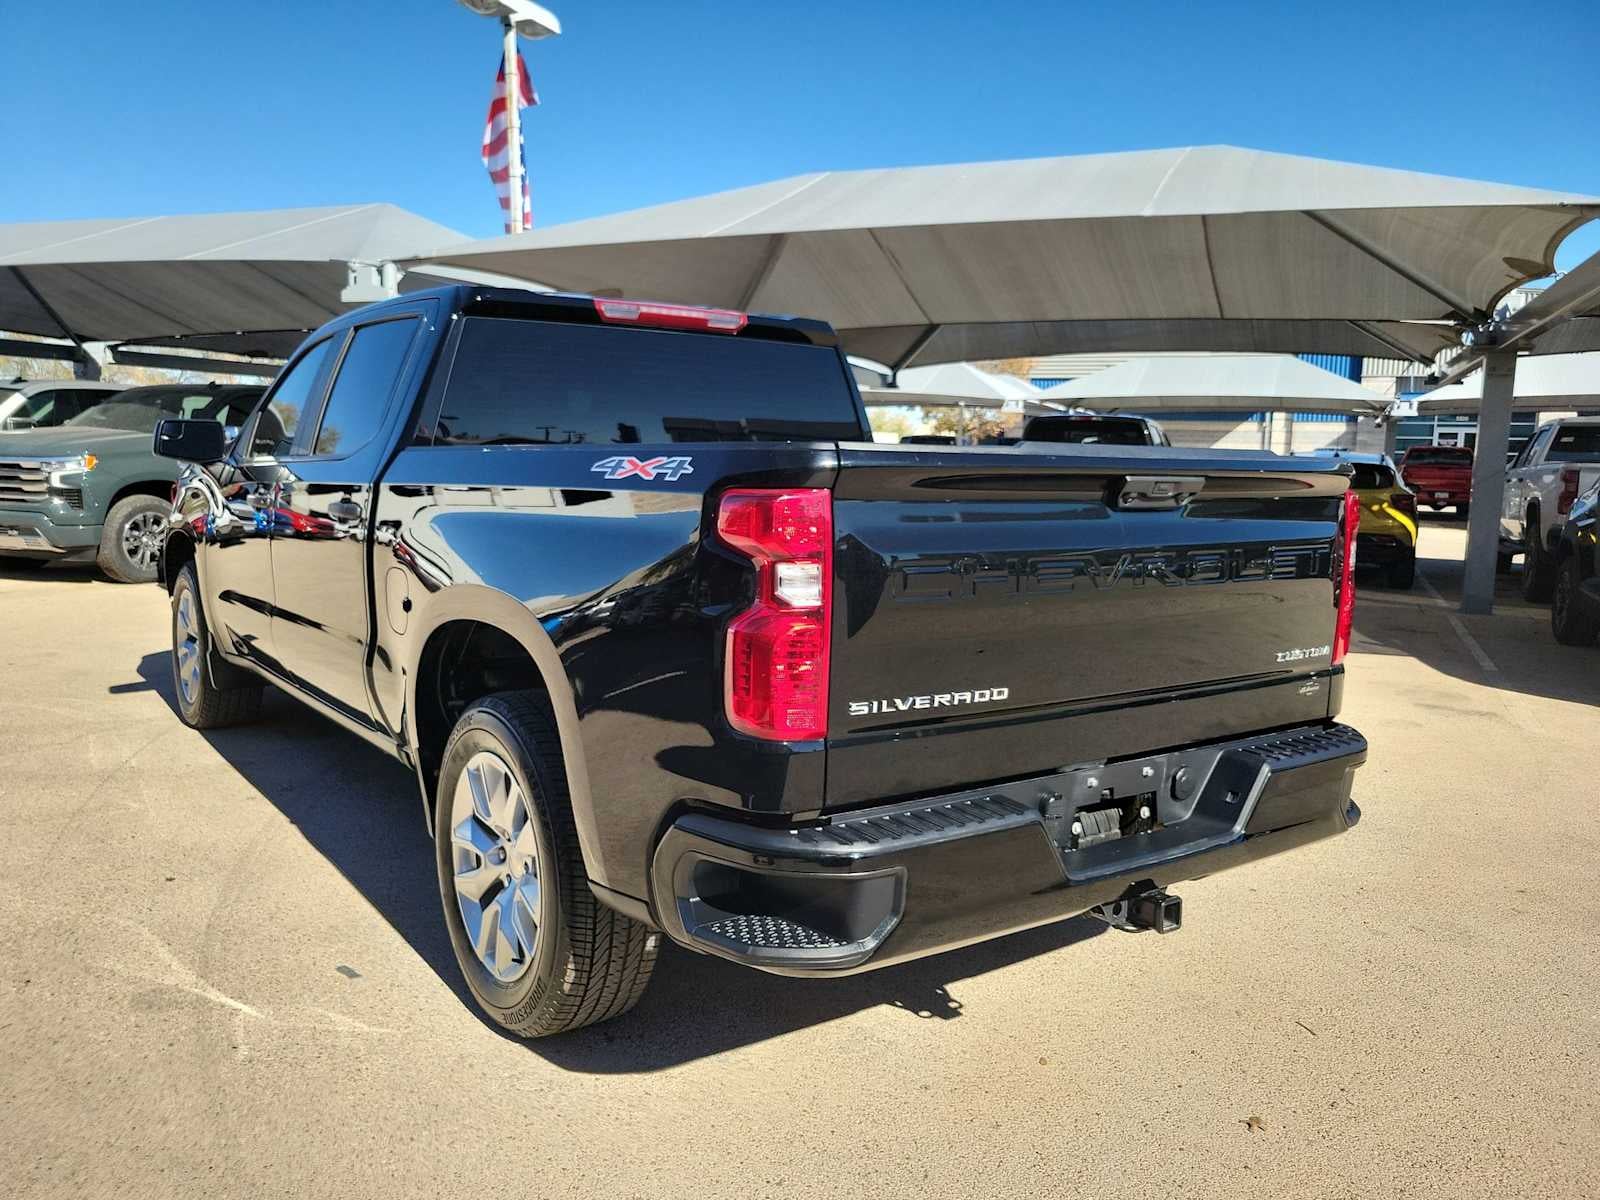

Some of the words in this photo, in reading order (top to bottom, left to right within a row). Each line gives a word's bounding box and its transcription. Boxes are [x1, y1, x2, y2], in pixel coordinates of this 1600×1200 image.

[891, 544, 1331, 602] CHEVROLET
[1275, 645, 1331, 662] CUSTOM
[848, 687, 1010, 716] SILVERADO
